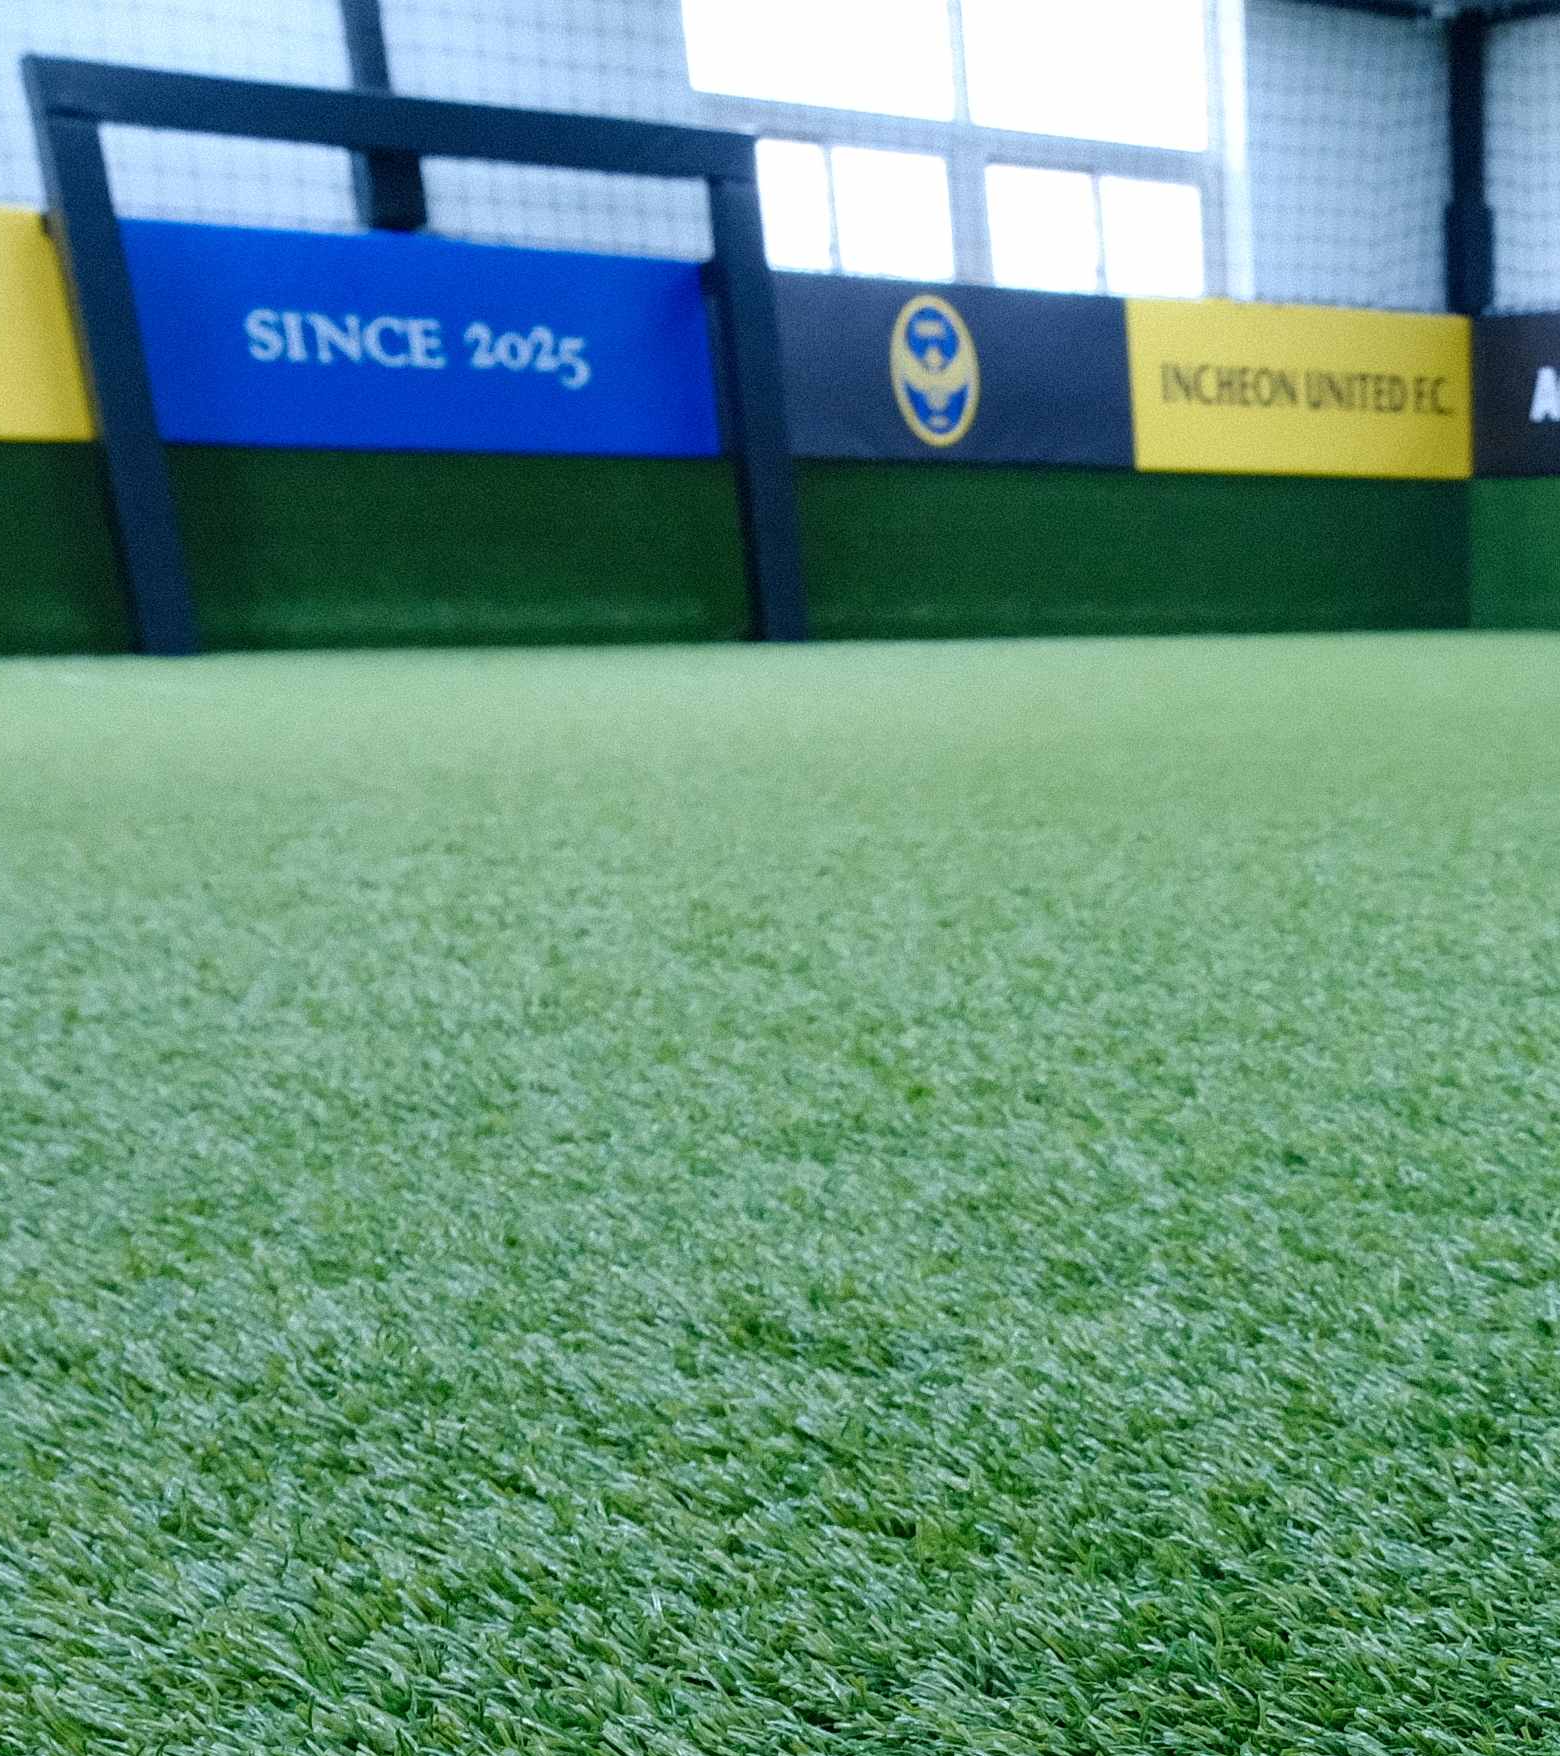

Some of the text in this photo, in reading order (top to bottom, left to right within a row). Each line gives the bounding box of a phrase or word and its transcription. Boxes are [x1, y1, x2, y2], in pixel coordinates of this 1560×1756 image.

[244, 307, 591, 390] SINCE 2025
[1160, 360, 1298, 408] INCHEON
[1304, 367, 1409, 415] UNITED
